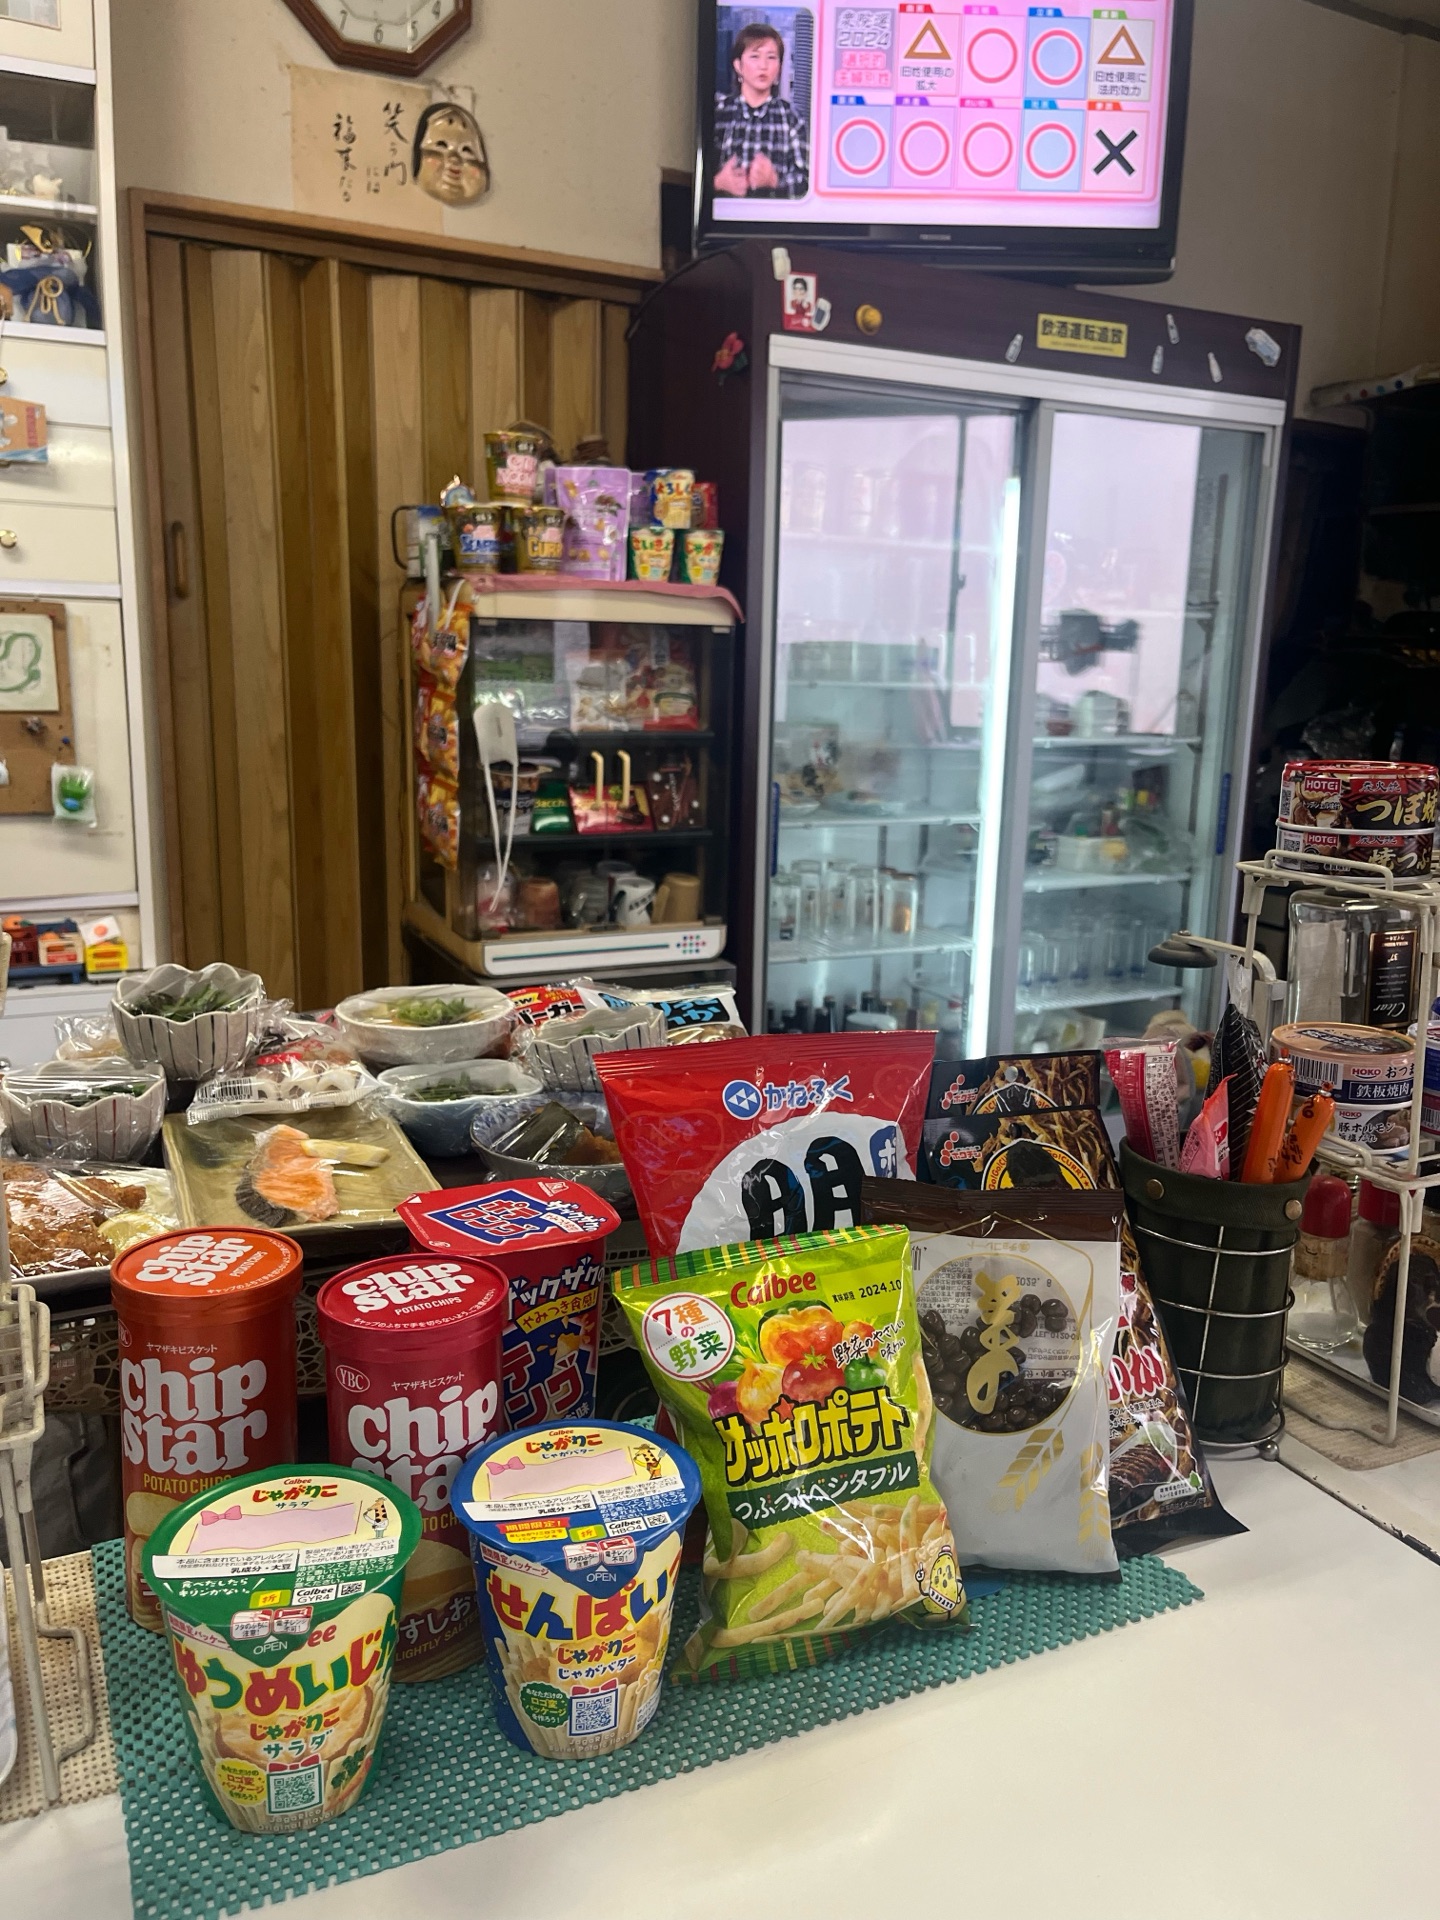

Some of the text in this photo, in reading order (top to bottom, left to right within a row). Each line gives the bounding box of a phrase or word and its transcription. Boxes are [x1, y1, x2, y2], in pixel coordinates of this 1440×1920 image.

[340, 10, 349, 32] 7
[374, 24, 384, 44] 6
[838, 31, 890, 47] 2024
[1358, 781, 1402, 792] 炭火焼
[1373, 1002, 1406, 1018] Clear
[1352, 1068, 1382, 1076] HOKO
[763, 1076, 854, 1109] かねふく
[1338, 1122, 1396, 1134] 豚ホルモン
[136, 1235, 216, 1282] chip
[172, 1238, 253, 1286] star
[342, 1262, 462, 1297] chip
[353, 1273, 475, 1313] star
[730, 1271, 817, 1309] Calbee
[395, 1296, 462, 1316] POTATO CHIPS
[652, 1298, 710, 1336] 7種
[681, 1325, 697, 1339] の
[668, 1329, 728, 1374] 野菜
[340, 1368, 365, 1389] YBC
[391, 1371, 466, 1392] ヤマザキビスケット
[121, 1357, 267, 1422] chip
[347, 1380, 498, 1459] chip
[123, 1409, 268, 1475] star
[525, 1433, 603, 1453] じゃがりこ
[549, 1429, 574, 1437] Calbee
[715, 1387, 908, 1486] サッポロポテト
[542, 1449, 595, 1460] じゃがバター
[143, 1473, 188, 1494] POTATO
[283, 1478, 312, 1486] Calbee
[252, 1484, 338, 1503] じゃがりこ
[275, 1500, 314, 1510] サラダ
[609, 1519, 641, 1530] Calbee
[176, 1552, 294, 1564] 本品に含まれているアレルゲン
[230, 1563, 292, 1574] 乳成分・大豆
[586, 1573, 617, 1582] OPEN
[182, 1578, 249, 1588] 食べだしたら
[296, 1587, 334, 1597] Calbee
[488, 1569, 668, 1641] せんぱい
[253, 1641, 288, 1655] OPEN
[557, 1633, 637, 1665] じゃがりこ
[558, 1655, 637, 1680] じゃがバター
[250, 1706, 340, 1741] じゃがりこ
[263, 1730, 333, 1759] サラダ
